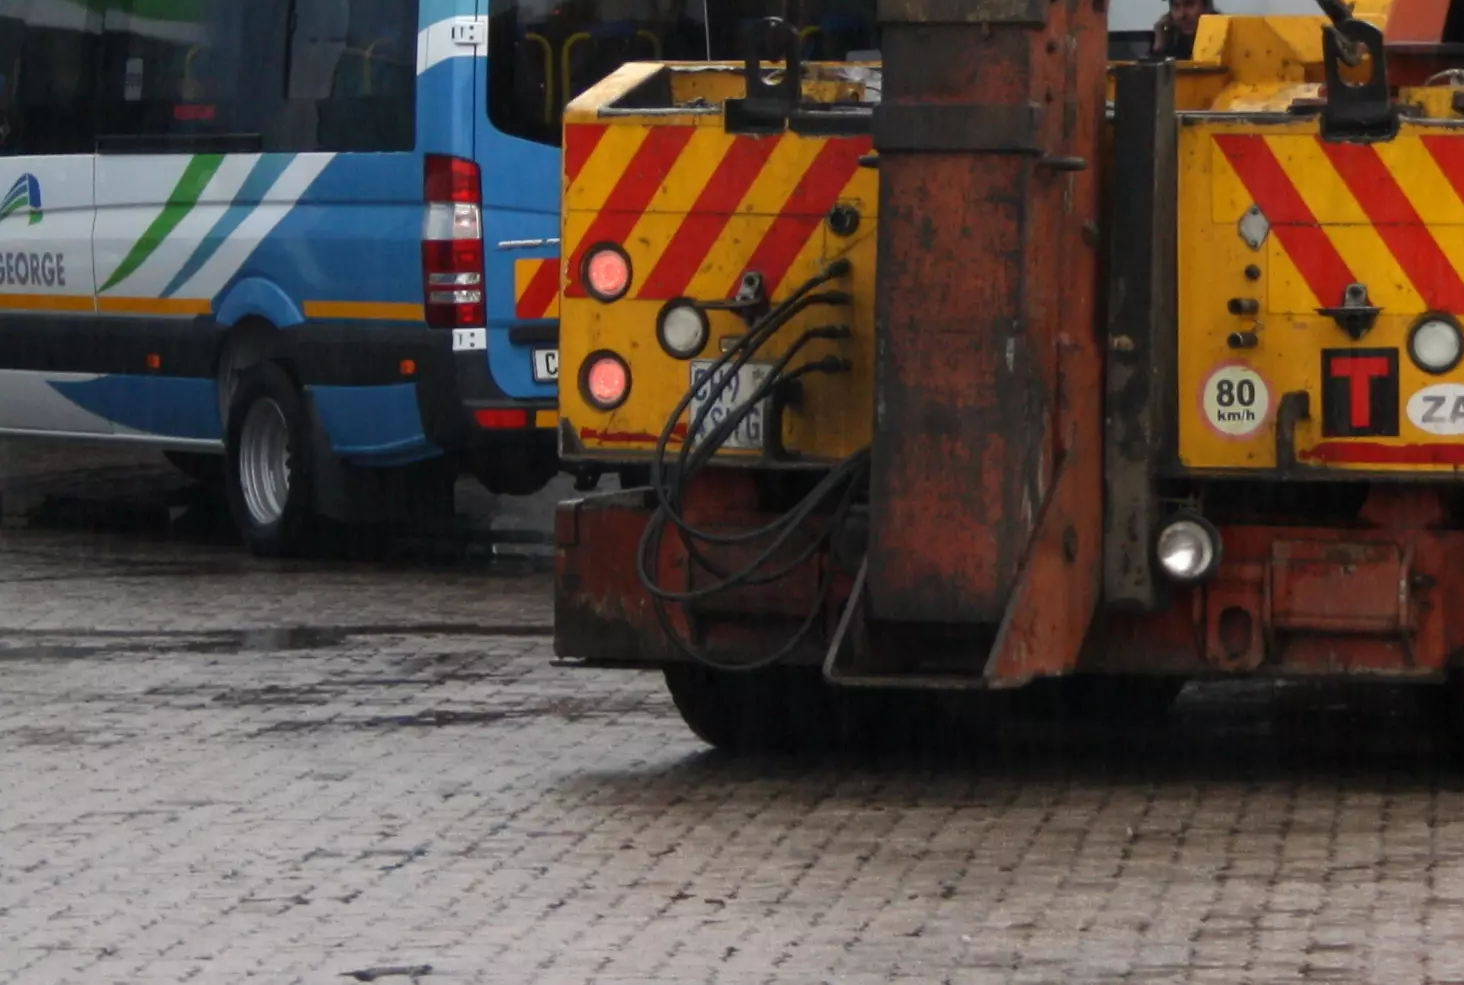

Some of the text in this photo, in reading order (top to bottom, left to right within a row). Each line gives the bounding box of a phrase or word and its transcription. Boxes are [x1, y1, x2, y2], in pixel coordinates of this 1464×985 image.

[1216, 379, 1256, 407] 80
[1330, 356, 1389, 428] T
[1217, 409, 1256, 424] km/h
